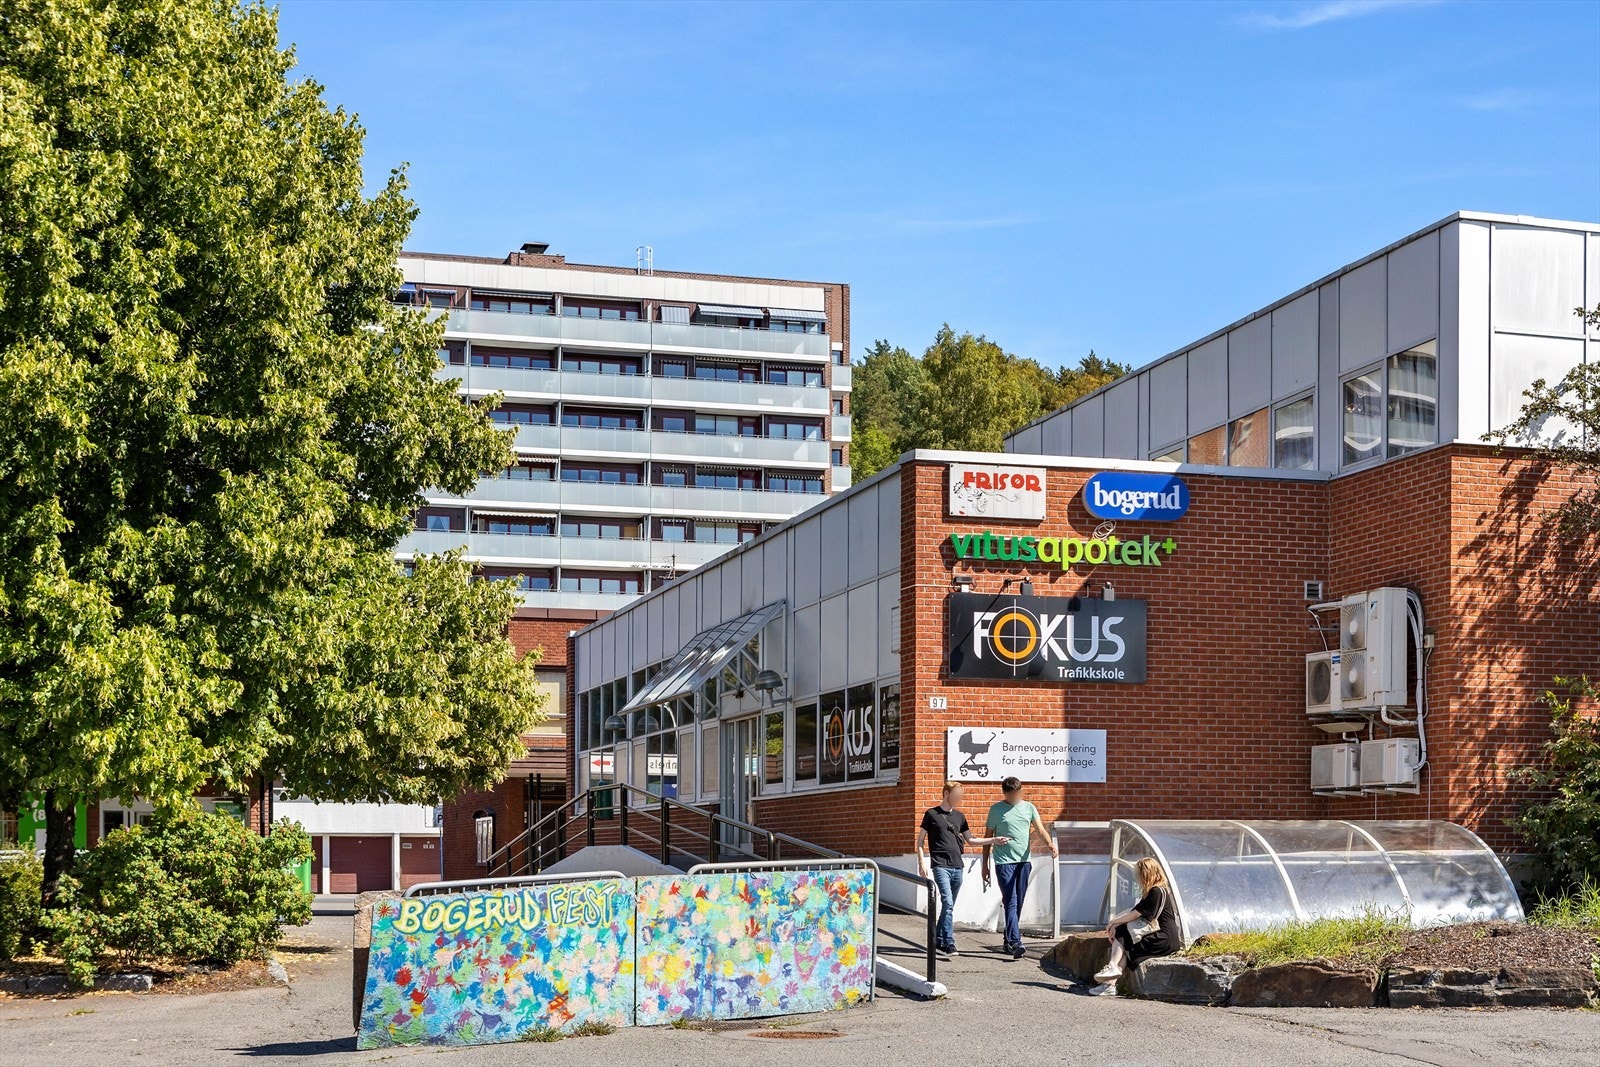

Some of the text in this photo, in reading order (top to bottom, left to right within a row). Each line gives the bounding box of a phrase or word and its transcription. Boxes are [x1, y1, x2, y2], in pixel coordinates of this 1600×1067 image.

[963, 471, 1042, 493] FRISØR
[1092, 481, 1182, 515] bogerud
[973, 610, 1126, 664] FOKUS
[1057, 666, 1125, 680] Trafikkskole
[932, 698, 945, 708] 97
[823, 705, 873, 761] FOKUS
[1002, 742, 1097, 755] Barnevognparkering
[1002, 756, 1096, 768] for åpen barnehage.
[392, 882, 620, 934] BOGERUD FEST
